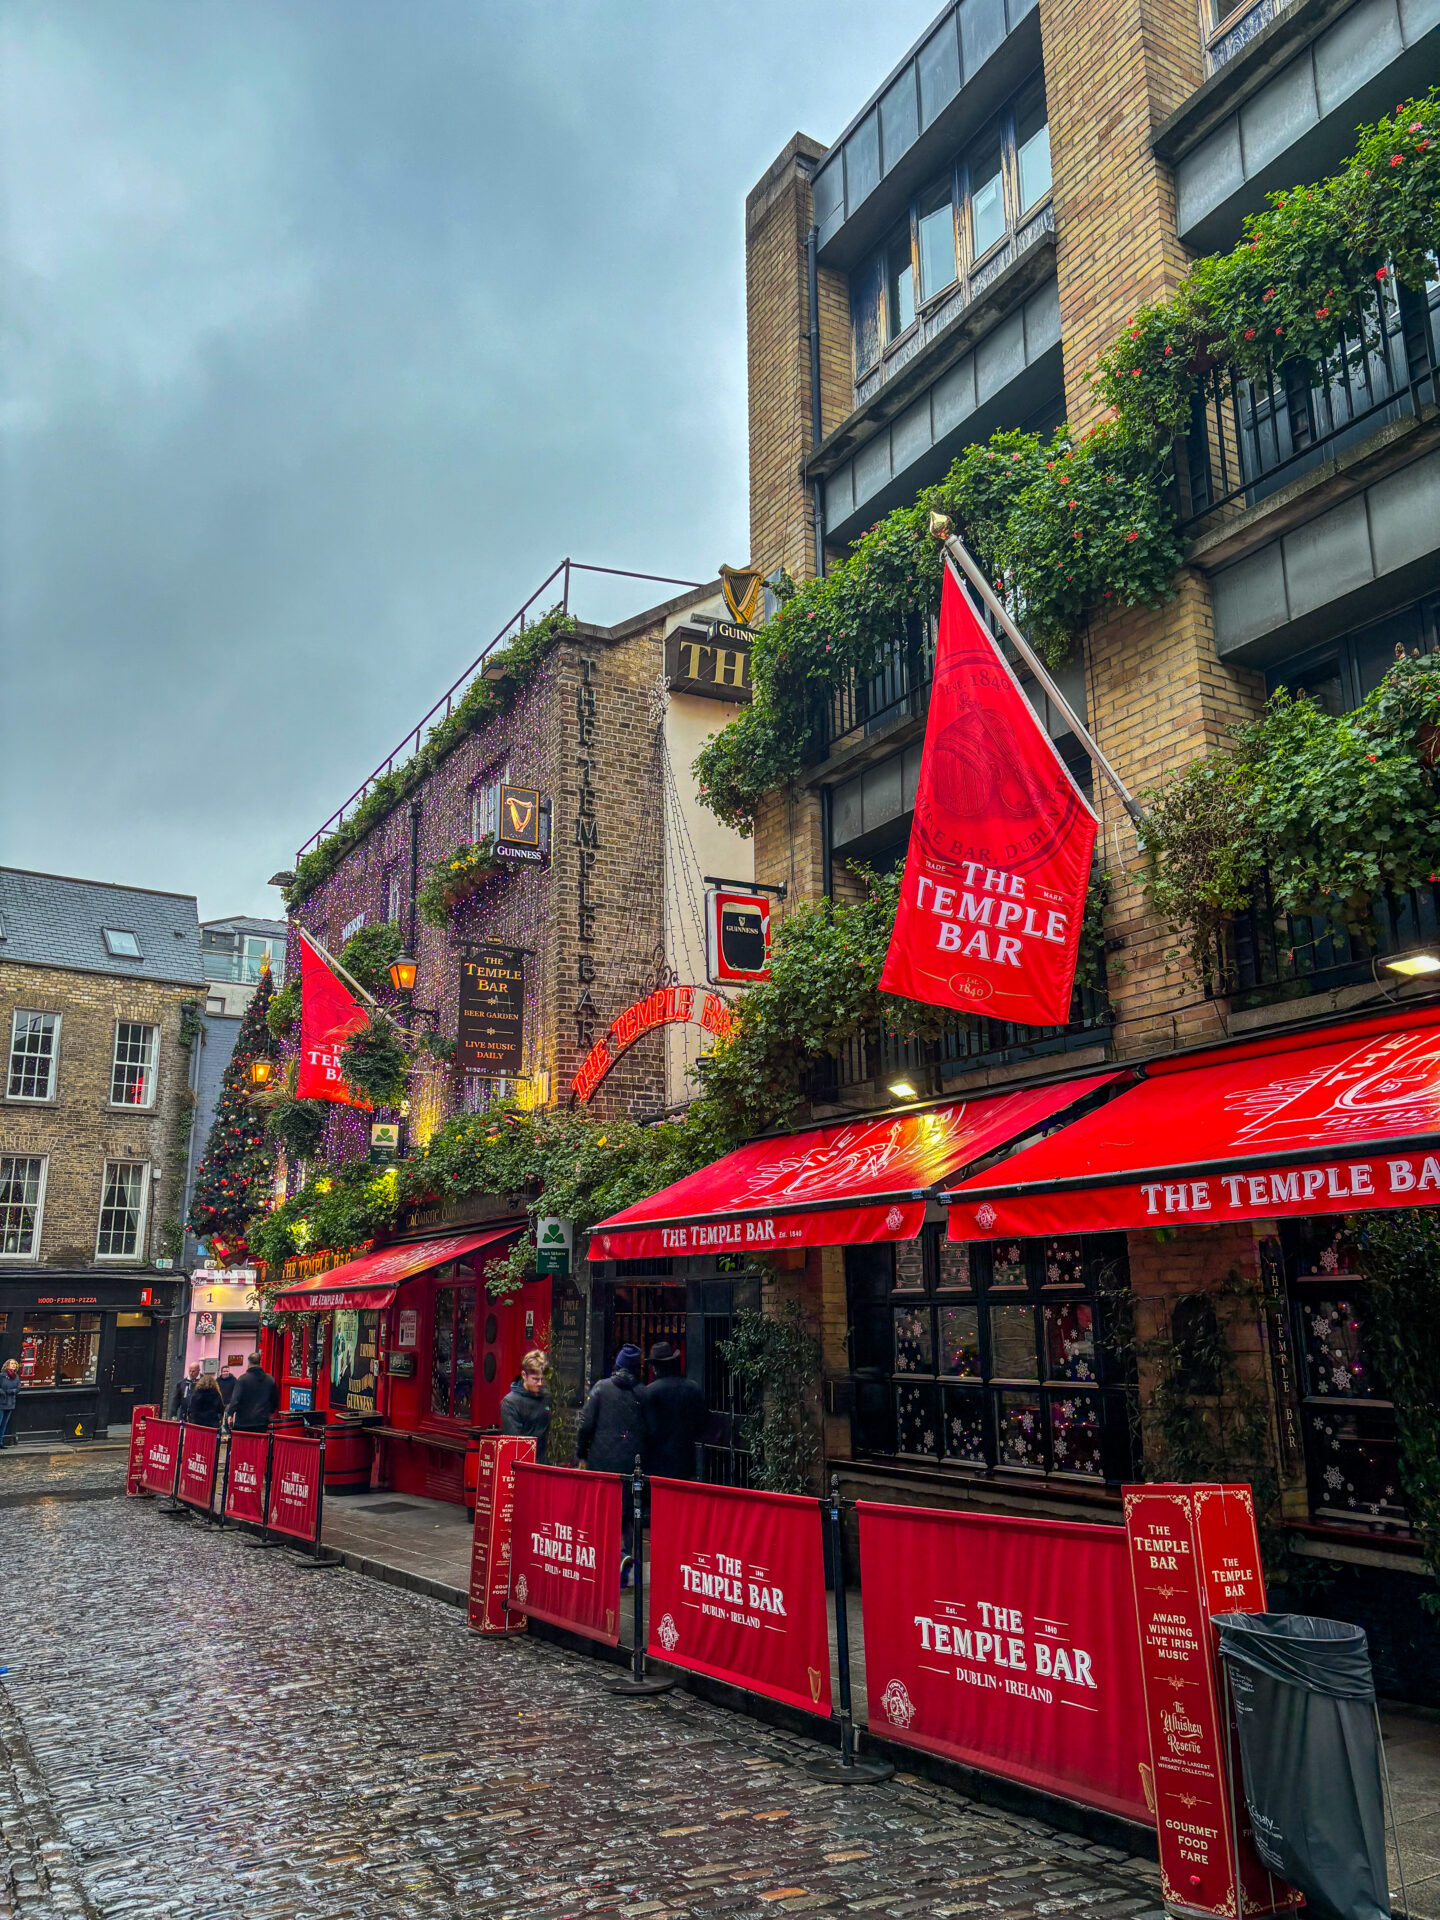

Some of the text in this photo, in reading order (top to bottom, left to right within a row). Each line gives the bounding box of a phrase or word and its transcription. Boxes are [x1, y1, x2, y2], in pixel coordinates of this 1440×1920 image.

[719, 623, 760, 643] GUINN
[971, 669, 1011, 691] 1840
[496, 846, 542, 860] GUINNESS
[573, 656, 600, 1048] THE TEMPLE BAR
[962, 861, 1027, 898] THE
[1043, 891, 1063, 902] MARK
[917, 875, 1068, 944] TEMPLE
[726, 925, 759, 935] GUINNESS
[936, 921, 1023, 968] BAR
[484, 956, 504, 966] THE
[464, 963, 522, 980] TEMPLE
[477, 979, 509, 993] BAR
[464, 1010, 519, 1021] BEER GARDEN
[465, 1041, 516, 1051] LIVE MUSIC
[570, 1038, 611, 1103] THE
[611, 985, 696, 1049] TEMPLE
[308, 1051, 341, 1067] TEM
[476, 1051, 504, 1060] DAILY
[1140, 1182, 1212, 1214] THE
[1221, 1164, 1374, 1208] TEMPLE
[661, 1228, 688, 1248] THE
[690, 1224, 742, 1246] TEMPLE
[746, 1219, 775, 1242] BAR
[299, 1256, 330, 1277] TEMPLE
[310, 1295, 318, 1306] THE
[318, 1294, 335, 1305] TEMPLE
[335, 1293, 344, 1304] BAR
[346, 1393, 374, 1412] GUINNESS
[1286, 1408, 1297, 1449] BAR
[291, 1472, 300, 1482] THE
[281, 1479, 309, 1499] TEMPLE BAR
[554, 1522, 573, 1541] THE
[1148, 1525, 1171, 1536] THE
[531, 1532, 573, 1563] TEMPLE
[576, 1545, 597, 1570] BAR
[1134, 1537, 1190, 1554] TEMPLE
[716, 1553, 743, 1578] THE
[1149, 1556, 1179, 1571] BAR
[1222, 1558, 1239, 1567] THE
[1212, 1569, 1253, 1583] TEMPLE
[680, 1564, 787, 1616] TEMPLE BAR
[1224, 1584, 1245, 1597] BAR
[701, 1603, 761, 1629] DUBLIN IRELAND
[946, 1601, 1058, 1635] Est. THE 1840
[1153, 1613, 1187, 1625] AWARD
[1148, 1624, 1193, 1638] WINNING
[1146, 1635, 1198, 1650] LIVE IRISH
[914, 1616, 1098, 1689] TEMPLE BAR
[1158, 1649, 1189, 1661] MUSIC
[955, 1667, 1053, 1704] DUBLIN IRELAND
[1173, 1701, 1185, 1714] The
[1160, 1709, 1204, 1739] Whiskey
[1167, 1733, 1201, 1756] Reserve
[1158, 1762, 1215, 1778] WHISKEY COLLECTION
[1187, 1760, 1210, 1770] LARGEST
[1165, 1819, 1218, 1839] GOURMET
[1178, 1835, 1208, 1850] FOOD
[1180, 1851, 1209, 1865] FARE
